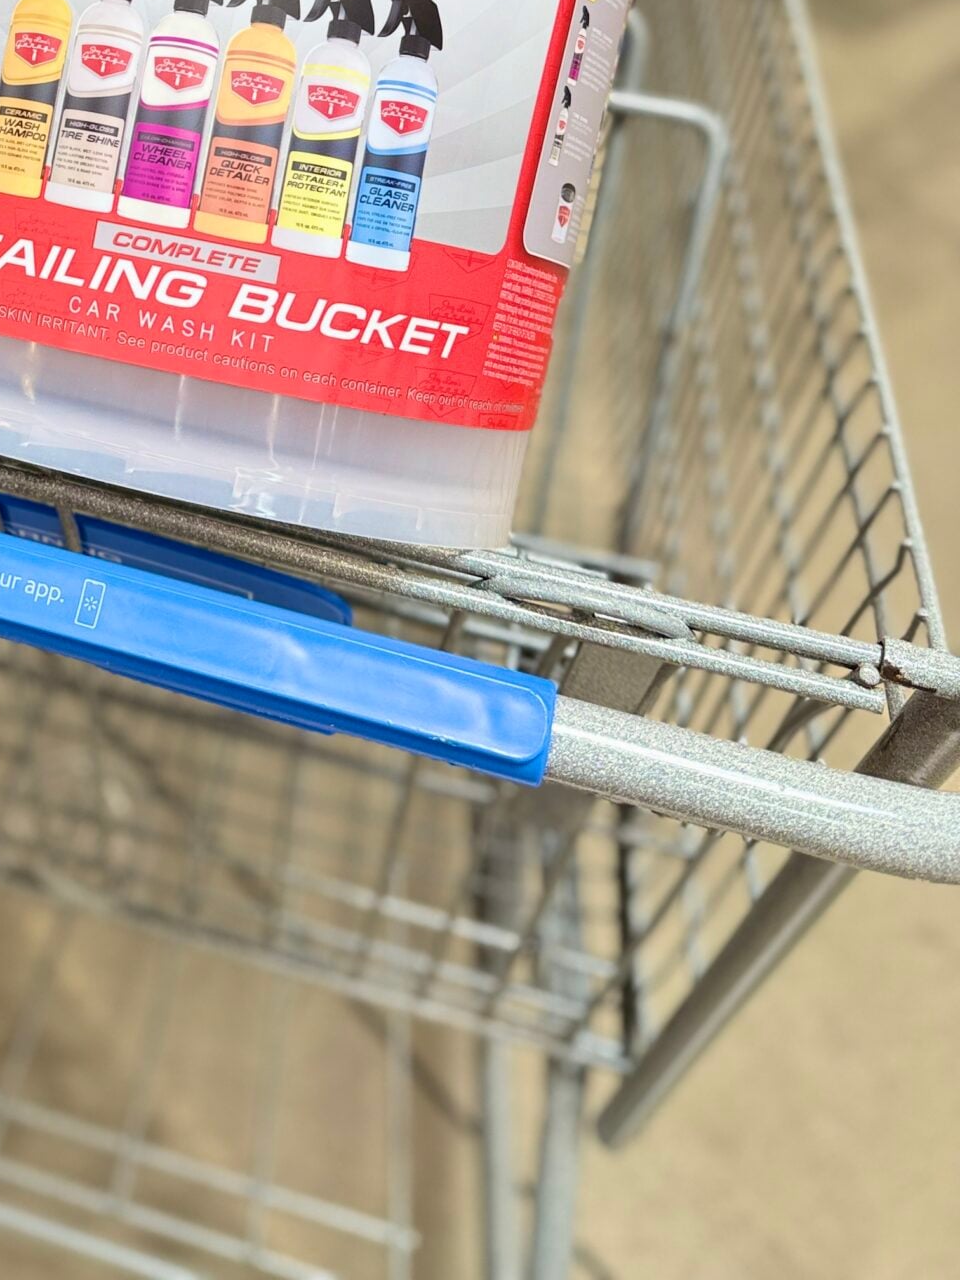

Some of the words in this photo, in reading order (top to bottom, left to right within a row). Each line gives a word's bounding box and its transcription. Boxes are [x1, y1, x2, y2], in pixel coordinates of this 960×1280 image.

[5, 107, 43, 120] CERAMIC
[4, 117, 40, 132] WASH
[69, 120, 115, 134] HIGH-GLOSS
[60, 129, 84, 141] TIRE
[86, 134, 120, 148] SHINE
[133, 151, 193, 171] CLEANER
[142, 143, 187, 160] WHEEL
[209, 167, 271, 186] DETAILER
[220, 159, 263, 175] QUICK
[298, 164, 343, 177] INTERIOR
[286, 180, 347, 199] PROTECTANT
[369, 186, 410, 202] GLASS
[359, 194, 415, 214] CLEANER
[112, 230, 263, 273] COMPLETE
[68, 295, 121, 322] CAR
[139, 310, 215, 342] WASH
[230, 328, 275, 353] KIT
[227, 283, 471, 360] BUCKET
[36, 312, 110, 342] IRRITANT.
[116, 331, 146, 349] See
[150, 340, 209, 362] product
[212, 353, 276, 375] cautions
[280, 366, 298, 379] on
[303, 371, 337, 387] each
[406, 385, 438, 404] Keep
[438, 394, 456, 407] out
[457, 395, 470, 408] of
[470, 398, 492, 411] reach
[24, 577, 66, 606] app.
